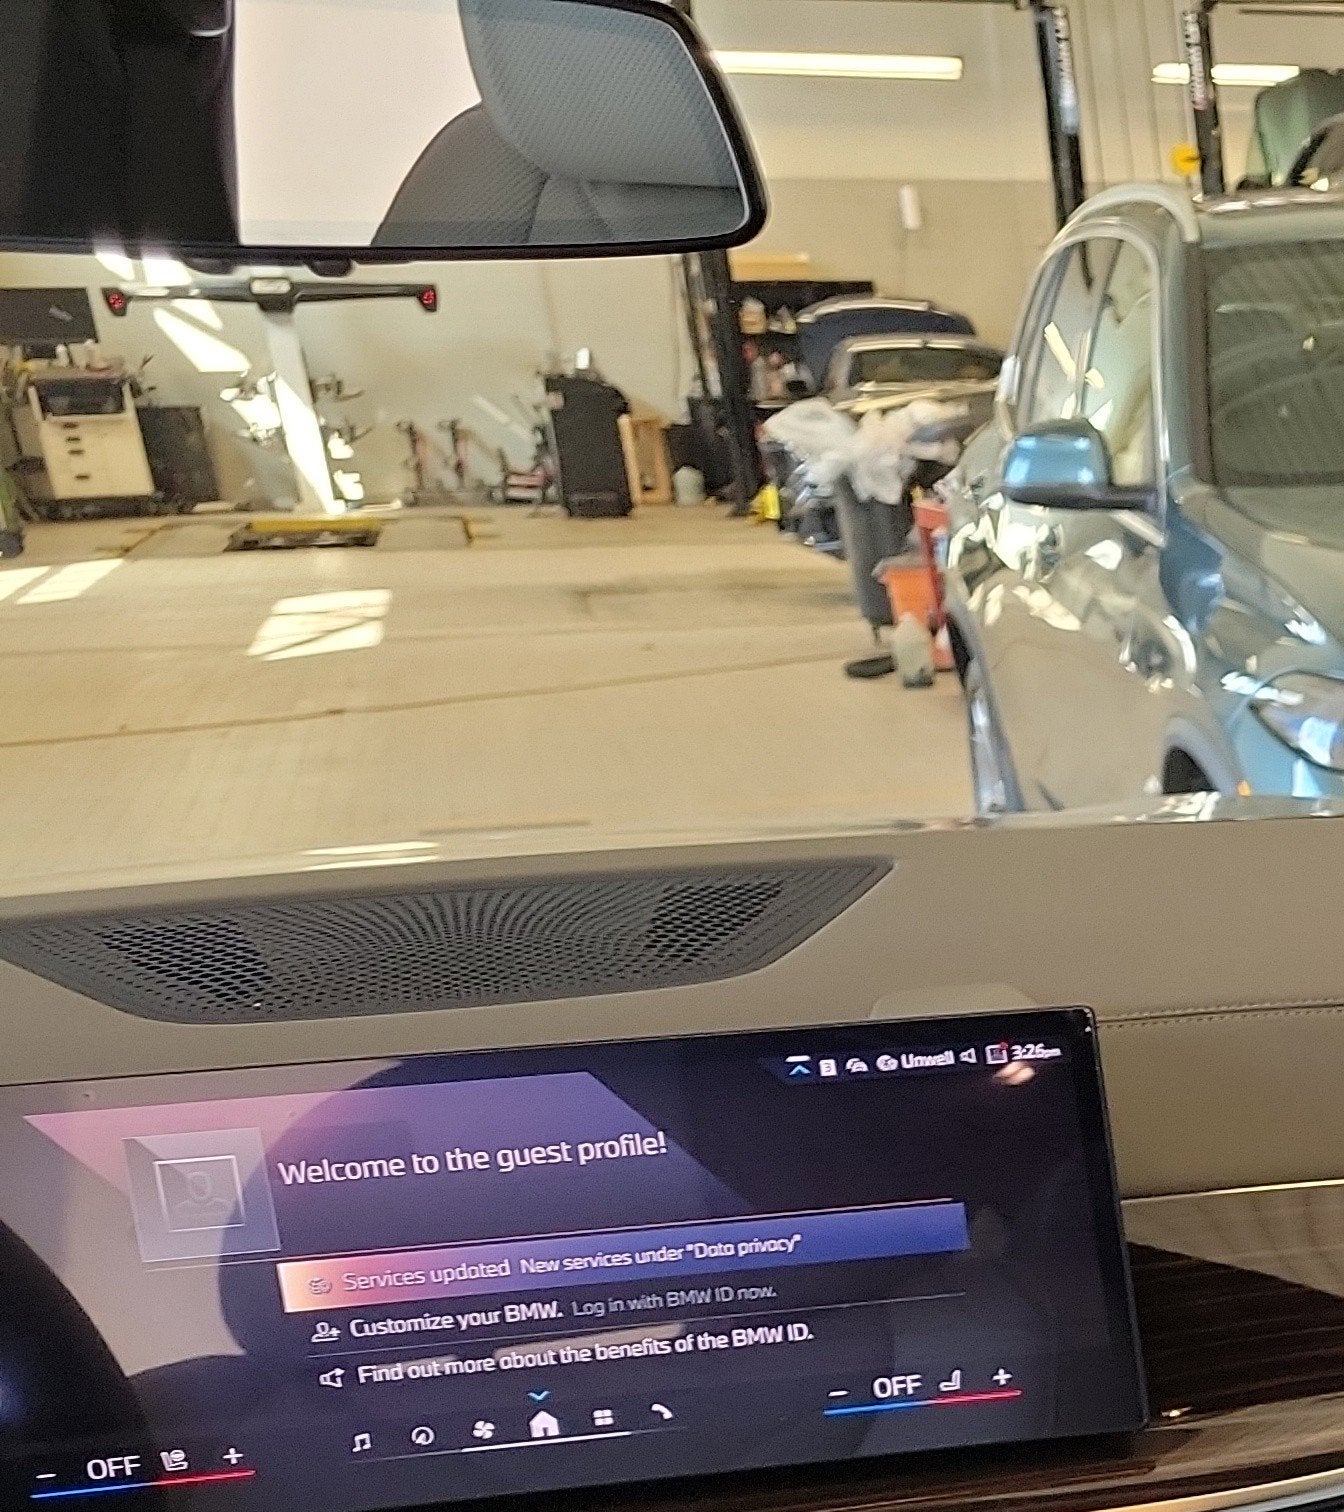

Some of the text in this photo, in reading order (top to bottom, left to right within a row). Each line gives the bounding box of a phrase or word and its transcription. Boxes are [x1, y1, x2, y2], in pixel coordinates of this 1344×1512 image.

[900, 1050, 956, 1069] Unwell
[277, 1130, 668, 1185] Welcome to the guest profile!
[341, 1233, 802, 1291] Services updated New services under "Data privacy"
[349, 1285, 778, 1338] Customize your BMW. Log in with BMW ID now.
[357, 1322, 815, 1384] Find out more about the benefits of the BMW ID.
[872, 1373, 923, 1400] OFF
[86, 1454, 141, 1480] OFF
